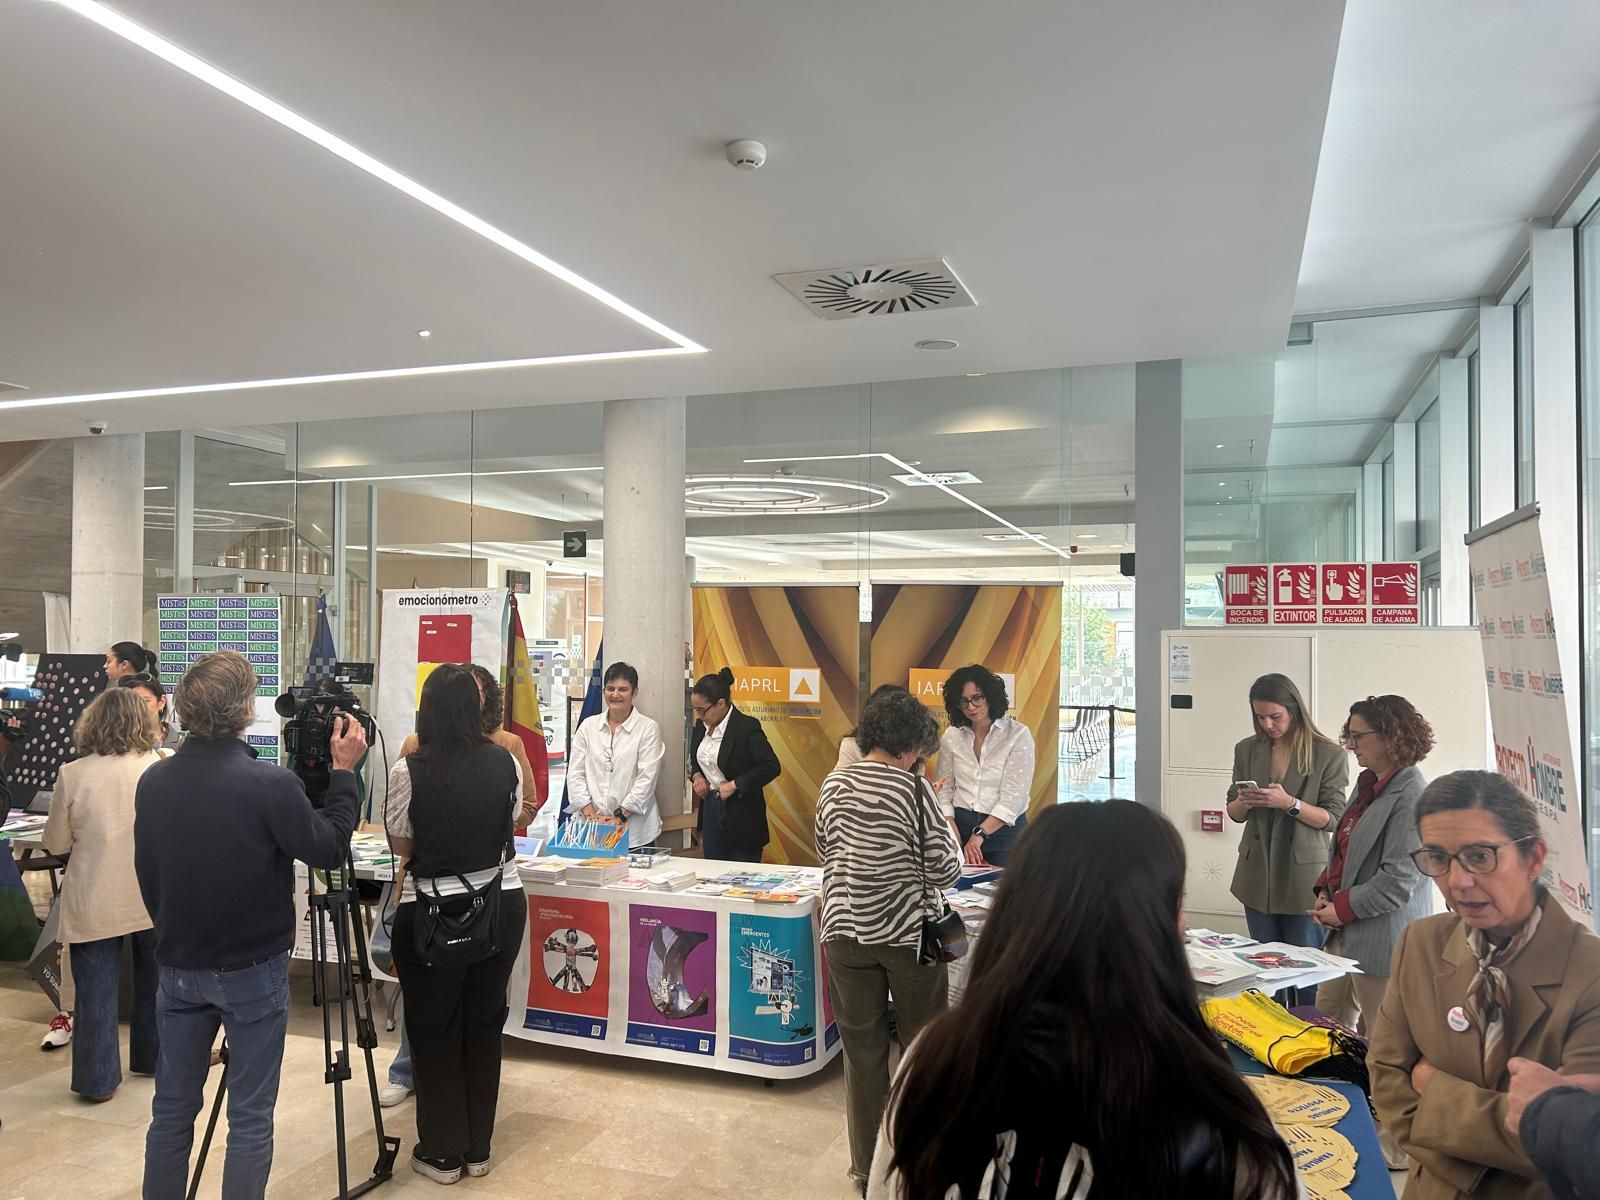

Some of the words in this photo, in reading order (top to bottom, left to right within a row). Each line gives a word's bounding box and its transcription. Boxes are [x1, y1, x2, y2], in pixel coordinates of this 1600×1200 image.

[398, 594, 478, 606] emocionómetro
[1274, 610, 1316, 622] EXTINTOR
[734, 678, 782, 692] IAPRL
[918, 681, 944, 695] IAP
[28, 688, 41, 699] tve
[1527, 736, 1567, 813] HOMBRE
[741, 930, 770, 938] EMERGENTES
[42, 967, 50, 978] YO
[49, 976, 62, 991] SUM
